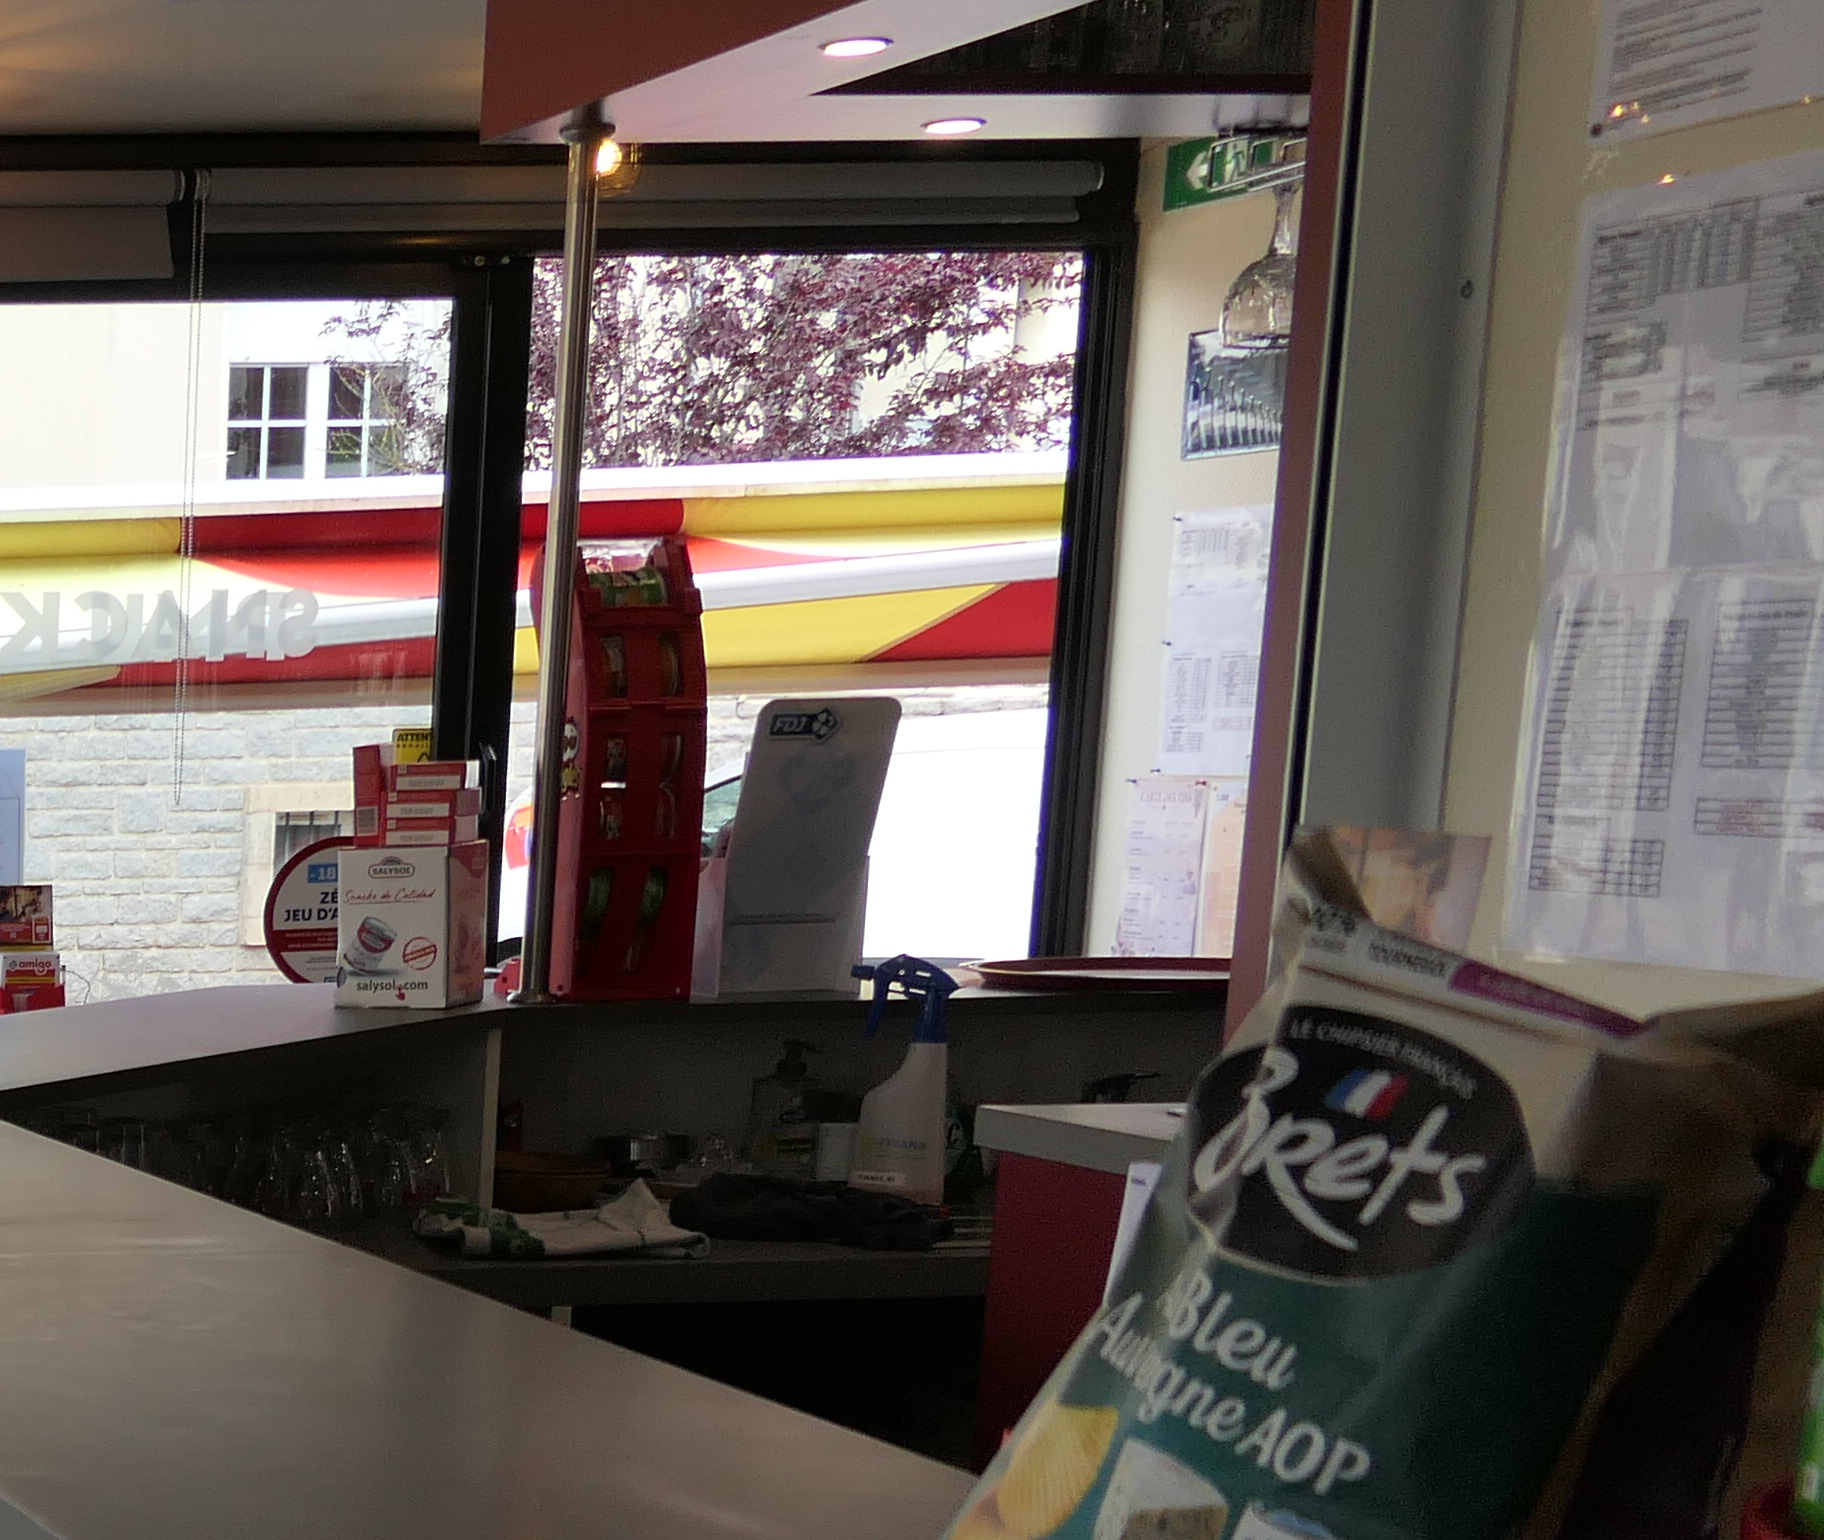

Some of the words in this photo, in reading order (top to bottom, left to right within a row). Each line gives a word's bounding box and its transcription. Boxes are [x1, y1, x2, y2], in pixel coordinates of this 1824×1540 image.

[773, 717, 807, 731] FDJ
[284, 909, 312, 922] JEU
[18, 958, 52, 976] amigo
[1164, 1270, 1298, 1391] Bleu
[1235, 1407, 1372, 1496] AOP
